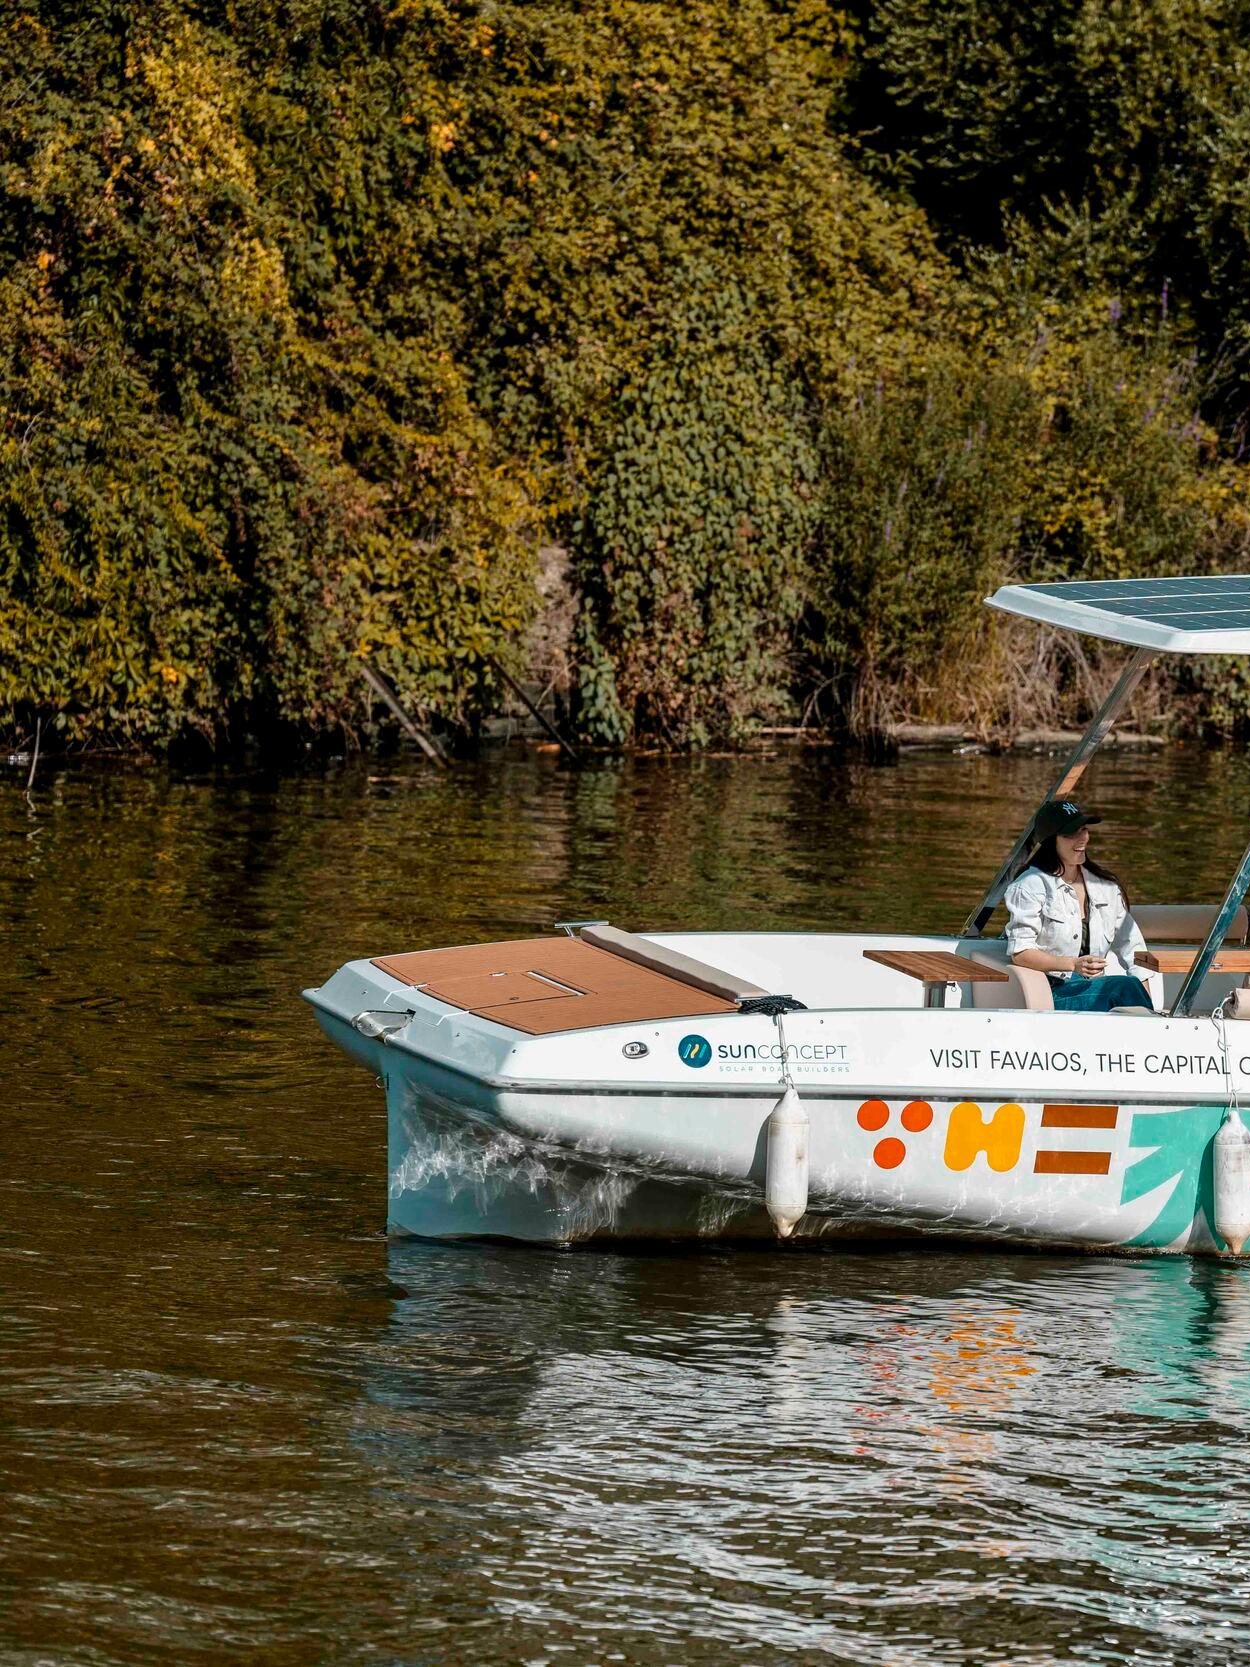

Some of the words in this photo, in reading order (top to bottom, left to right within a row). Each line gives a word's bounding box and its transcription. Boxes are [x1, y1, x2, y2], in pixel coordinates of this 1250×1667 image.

[719, 1065, 754, 1073] SOLAR
[930, 1049, 982, 1069] VISIT
[990, 1050, 1088, 1076] FAVAIOS,
[1095, 1053, 1136, 1073] THE
[1144, 1054, 1231, 1075] CAPITAL
